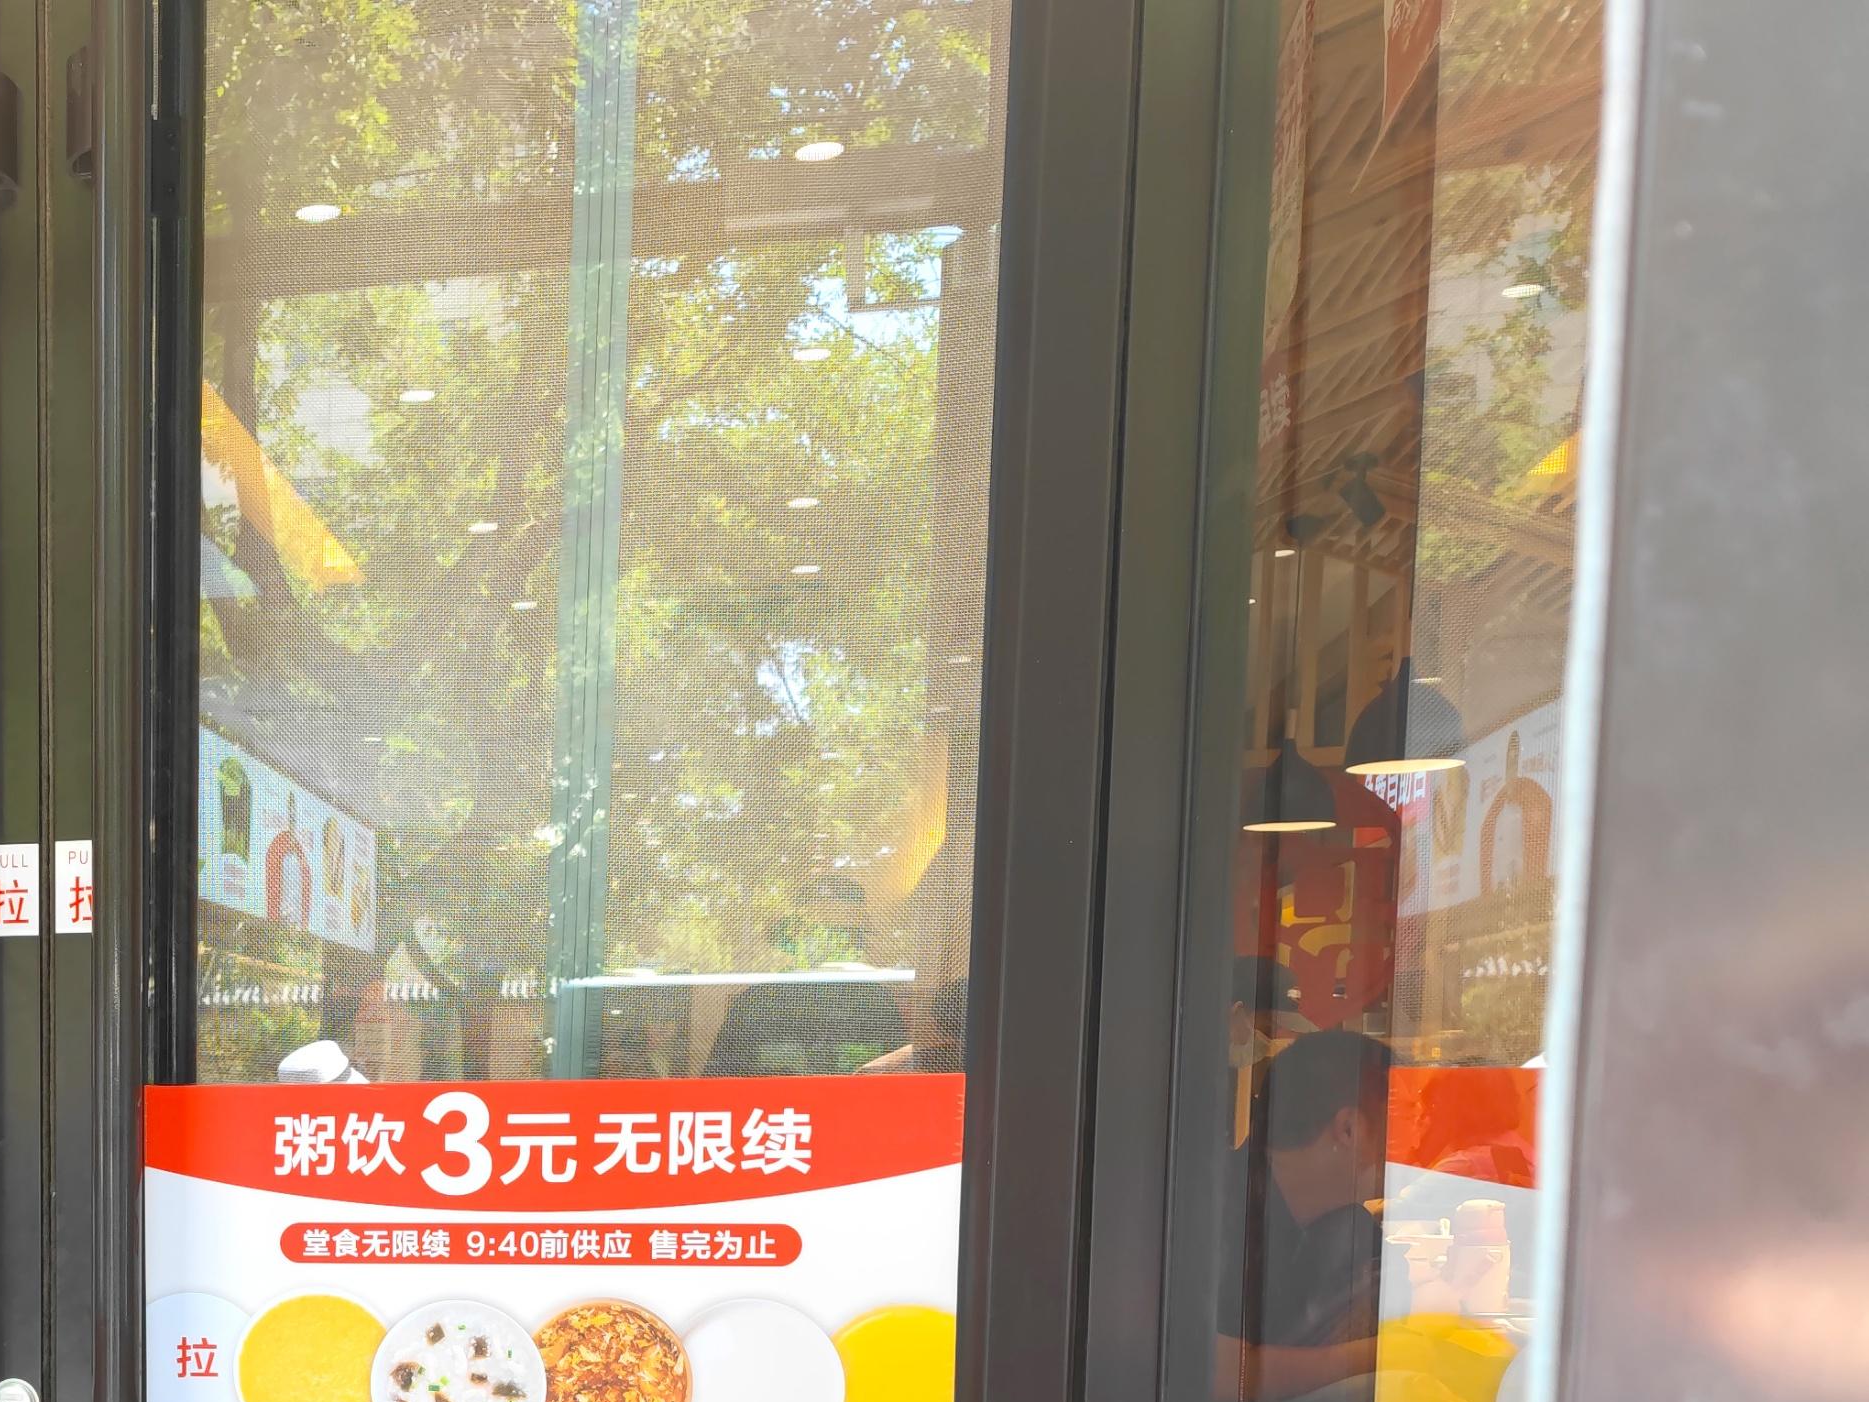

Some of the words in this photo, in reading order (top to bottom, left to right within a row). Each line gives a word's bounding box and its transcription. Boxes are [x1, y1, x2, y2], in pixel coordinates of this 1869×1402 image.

[68, 850, 90, 865] PU
[302, 1229, 451, 1258] 堂食无限续
[467, 1229, 633, 1260] 9:40前供应
[648, 1230, 777, 1261] 售完为止
[176, 1336, 219, 1378] 拉
